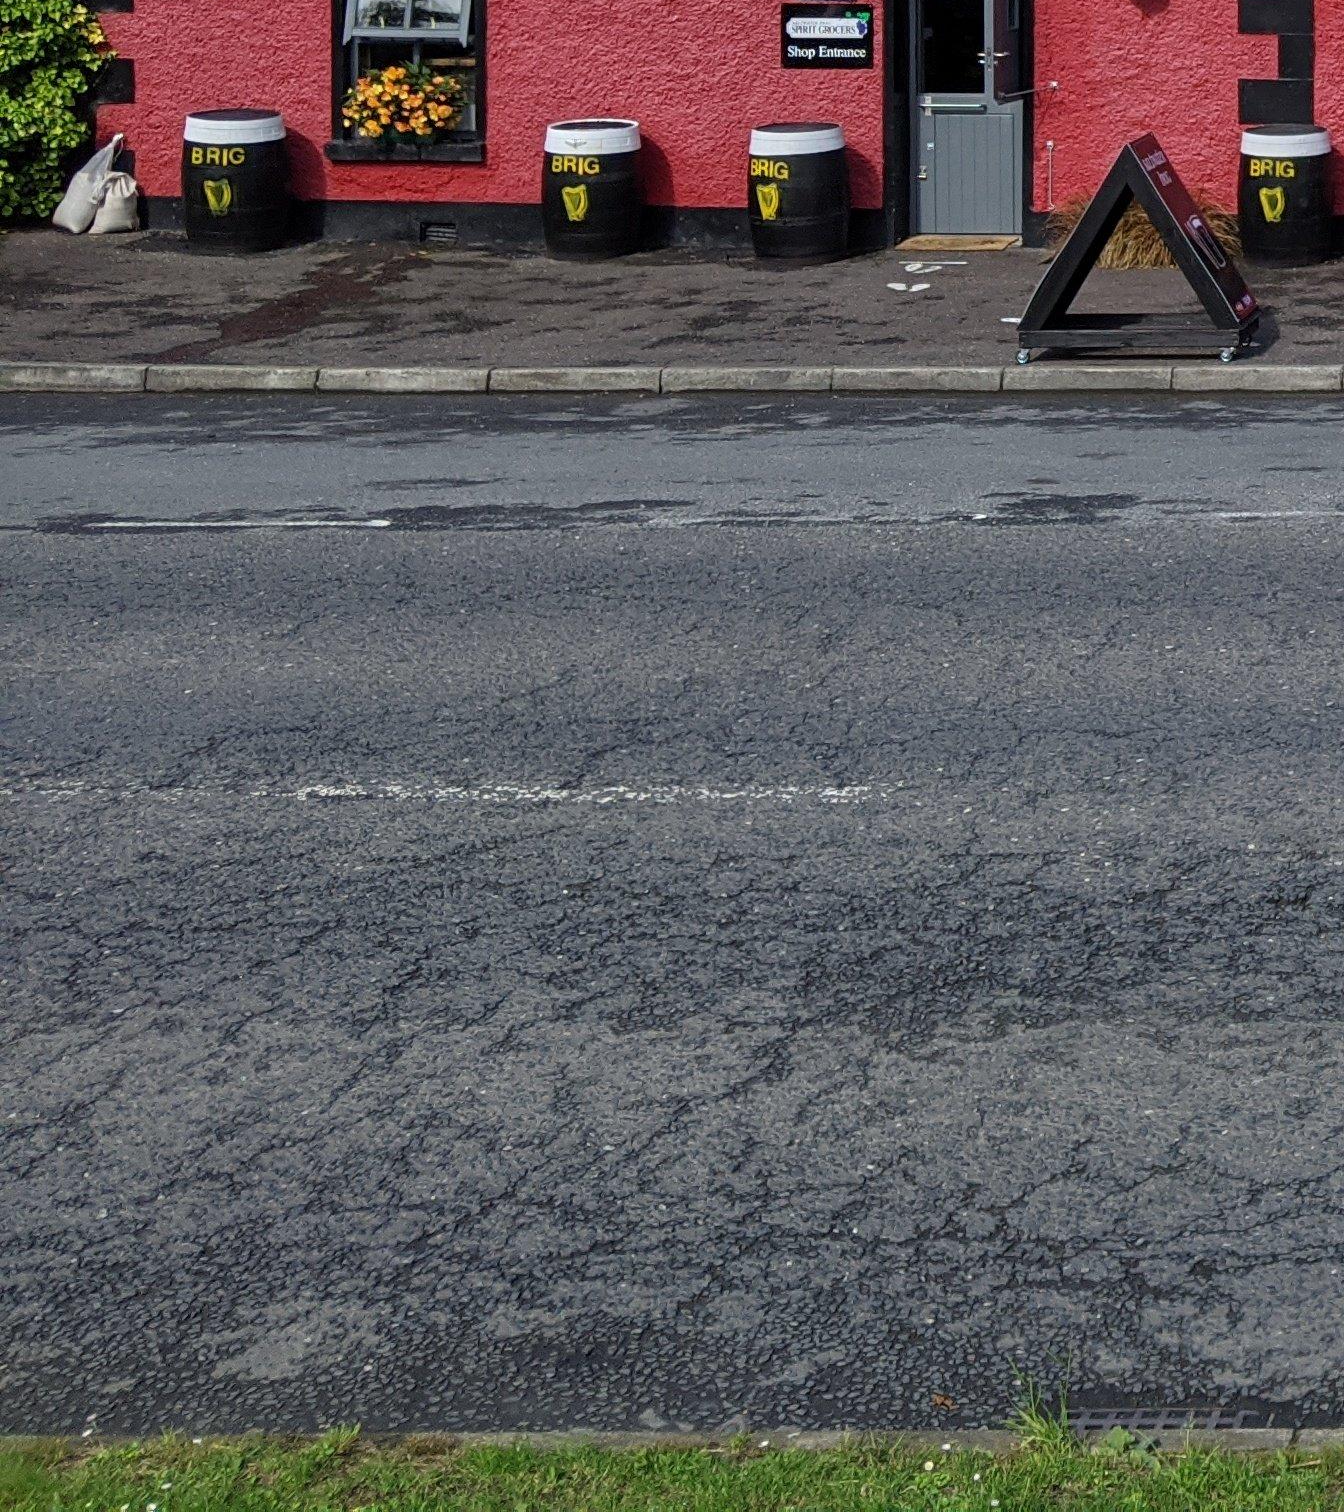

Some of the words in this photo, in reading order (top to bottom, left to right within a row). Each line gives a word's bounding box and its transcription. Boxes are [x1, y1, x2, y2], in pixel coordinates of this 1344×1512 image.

[791, 25, 816, 35] SPIRIT
[818, 25, 856, 35] GROCERS
[787, 44, 816, 60] Shop
[818, 45, 867, 58] Entrance
[191, 146, 246, 167] BRIG
[551, 155, 600, 176] BRIG
[750, 158, 789, 180] BRIG
[1249, 158, 1296, 178] BRIG
